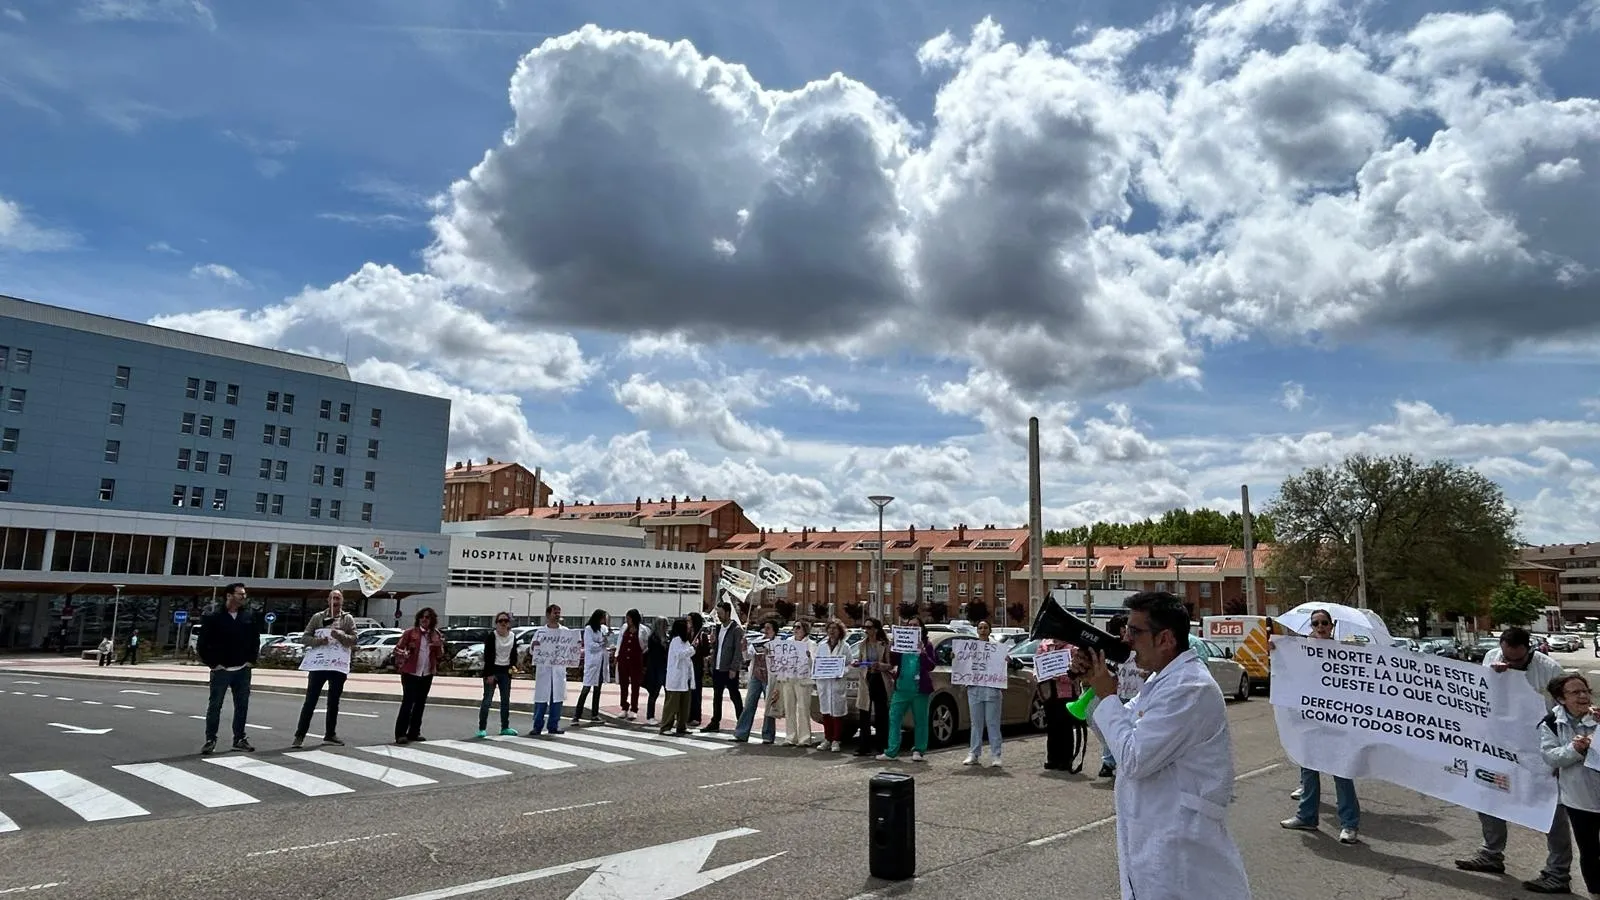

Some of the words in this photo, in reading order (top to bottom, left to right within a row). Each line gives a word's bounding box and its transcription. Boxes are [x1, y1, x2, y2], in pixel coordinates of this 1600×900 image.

[462, 549, 523, 561] HOSPITAL
[529, 553, 616, 566] UNIVERSITARIO
[620, 558, 651, 568] SANTA
[655, 559, 696, 570] BÁRBARA
[1212, 623, 1242, 634] Jara
[964, 642, 977, 650] NO
[984, 643, 997, 652] ES
[972, 662, 986, 671] ES
[1327, 649, 1372, 664] NORTE
[1376, 655, 1386, 666] A
[1390, 657, 1421, 673] SUR,
[1424, 663, 1441, 676] DE
[1444, 667, 1475, 685] ESTE
[1479, 677, 1488, 689] A
[1321, 662, 1369, 678] OESTE.
[1374, 669, 1392, 681] LA
[1396, 672, 1443, 691] LUCHA
[1447, 682, 1490, 706] SIGUE,
[1321, 676, 1374, 693] CUESTE
[1379, 684, 1398, 696] LO
[1403, 688, 1433, 703] QUE
[1301, 696, 1373, 716] DERECHOS
[1377, 708, 1461, 732] LABORALES
[1301, 709, 1348, 725] ¡COMO
[1351, 717, 1403, 735] TODOS
[1406, 726, 1435, 740] LOS
[1439, 732, 1520, 764] MORTALES!
